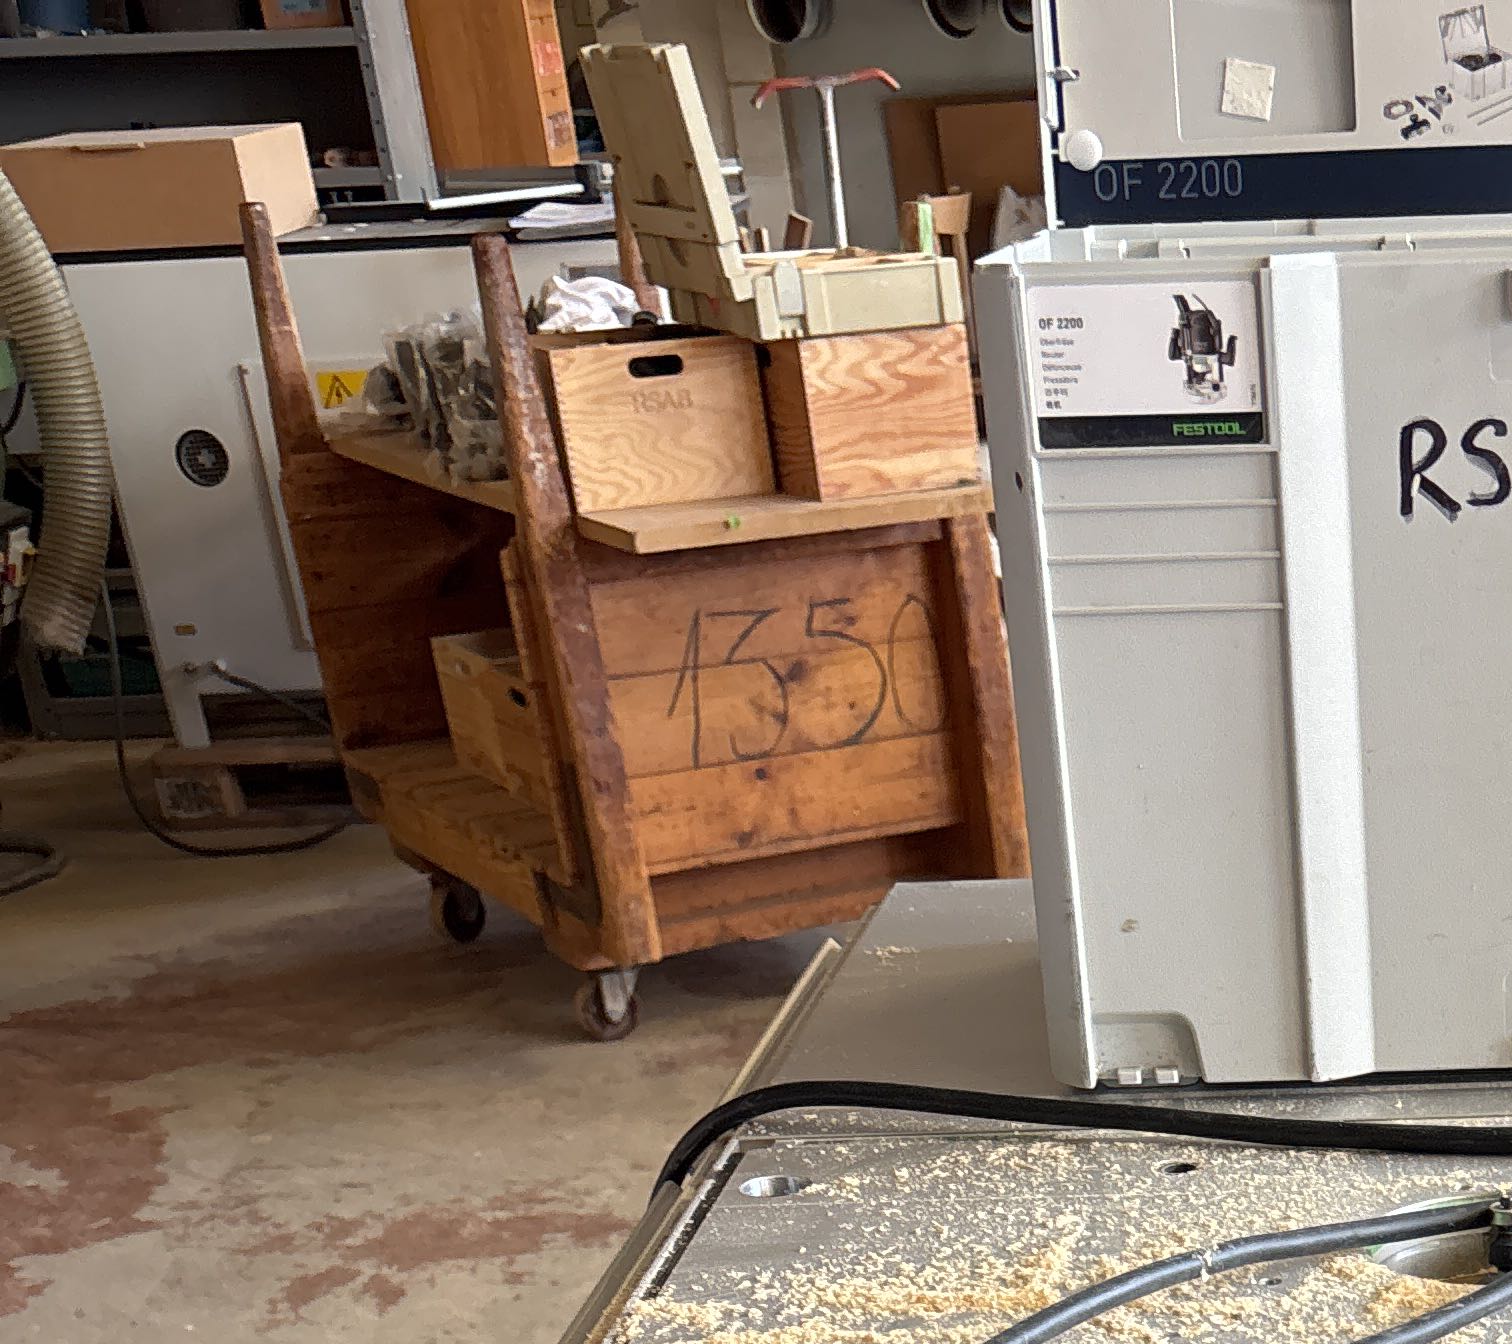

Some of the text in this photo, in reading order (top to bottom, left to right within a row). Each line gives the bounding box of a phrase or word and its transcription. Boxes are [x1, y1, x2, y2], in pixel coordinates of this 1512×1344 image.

[1094, 159, 1242, 201] OF 2200
[1039, 317, 1084, 330] OF 2200
[1173, 422, 1247, 436] FESTOOL
